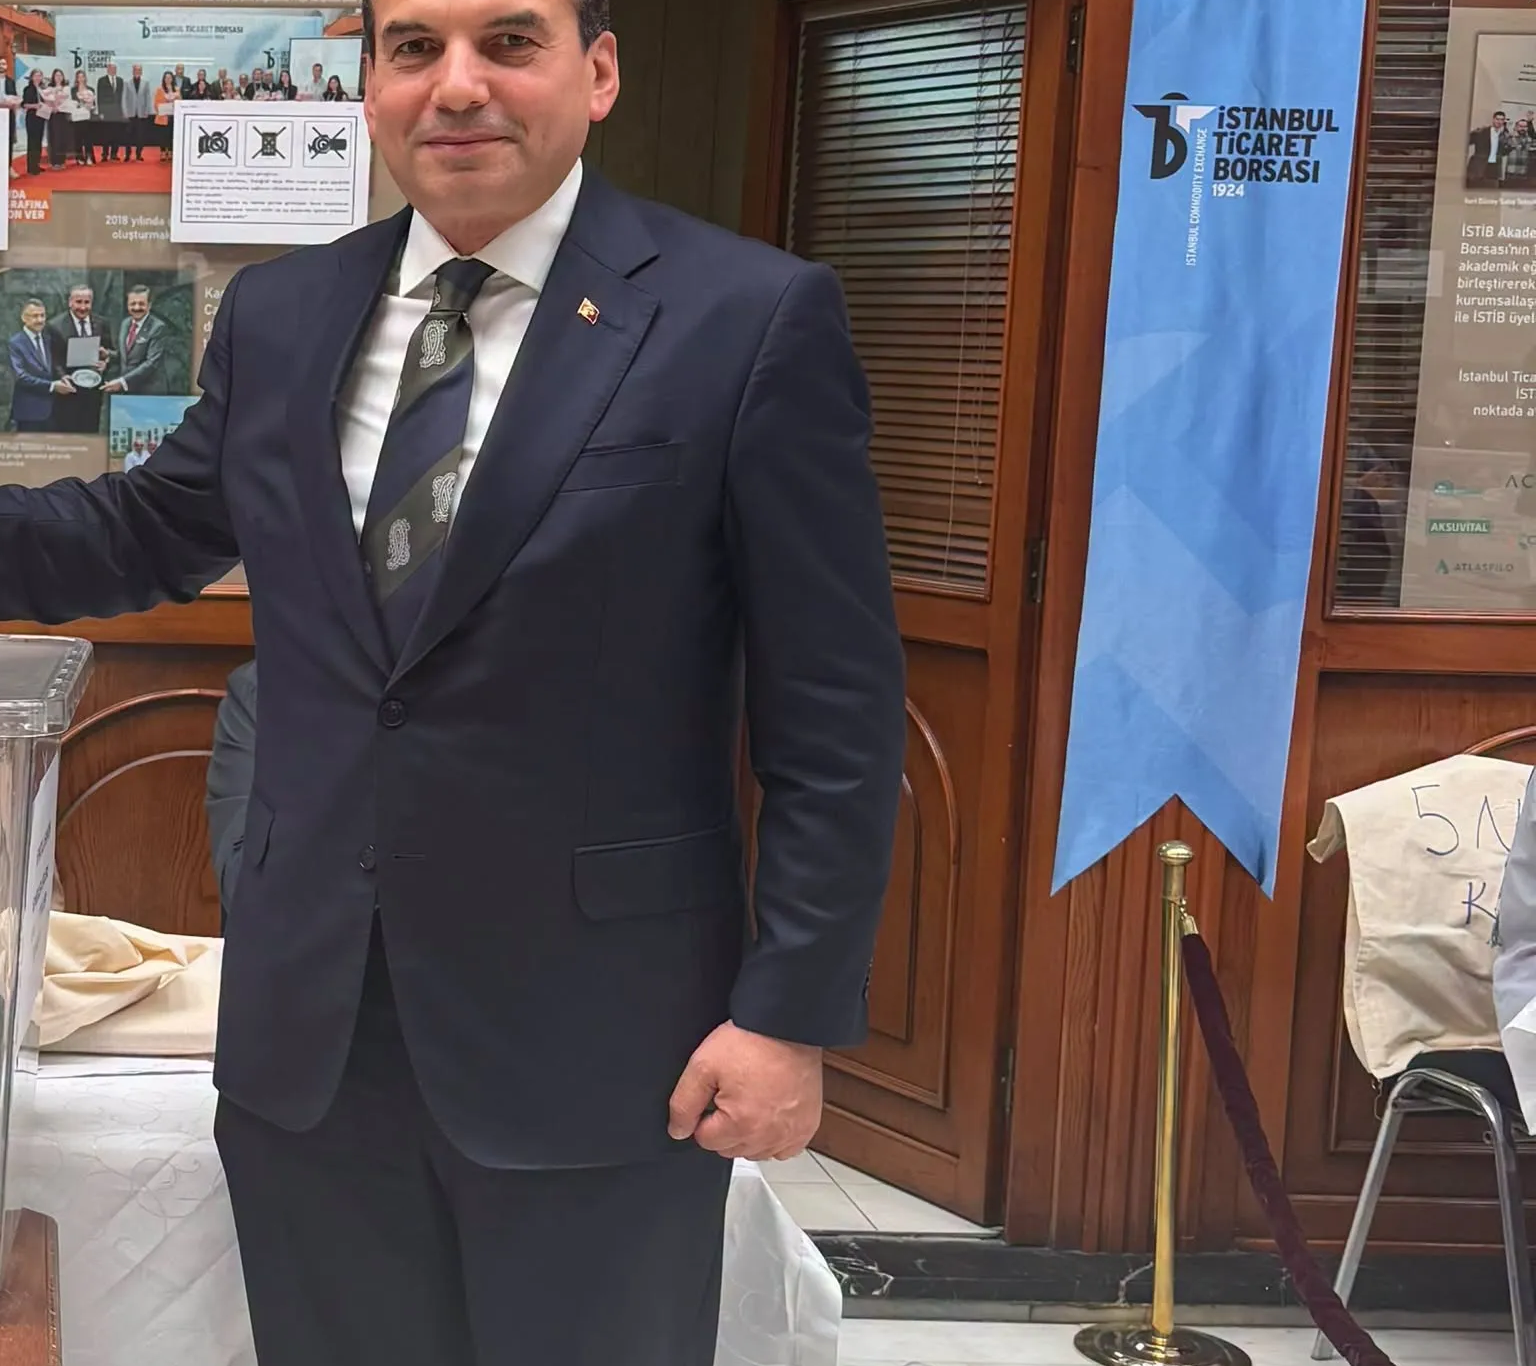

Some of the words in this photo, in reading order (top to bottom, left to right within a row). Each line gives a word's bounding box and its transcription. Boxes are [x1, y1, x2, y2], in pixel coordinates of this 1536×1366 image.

[1194, 127, 1208, 175] EXCHANGE
[1213, 157, 1321, 183] BORSASI
[1211, 184, 1245, 197] 1924
[10, 200, 49, 210] RAFINA
[1458, 260, 1519, 272] akademik
[1456, 294, 1536, 309] kurumsallaş
[1454, 310, 1470, 322] ile
[1473, 309, 1505, 323] İSTİB
[1459, 369, 1509, 383] İstanbul
[1473, 405, 1523, 417] noktada
[1411, 785, 1460, 856] 5
[1476, 794, 1522, 854] N
